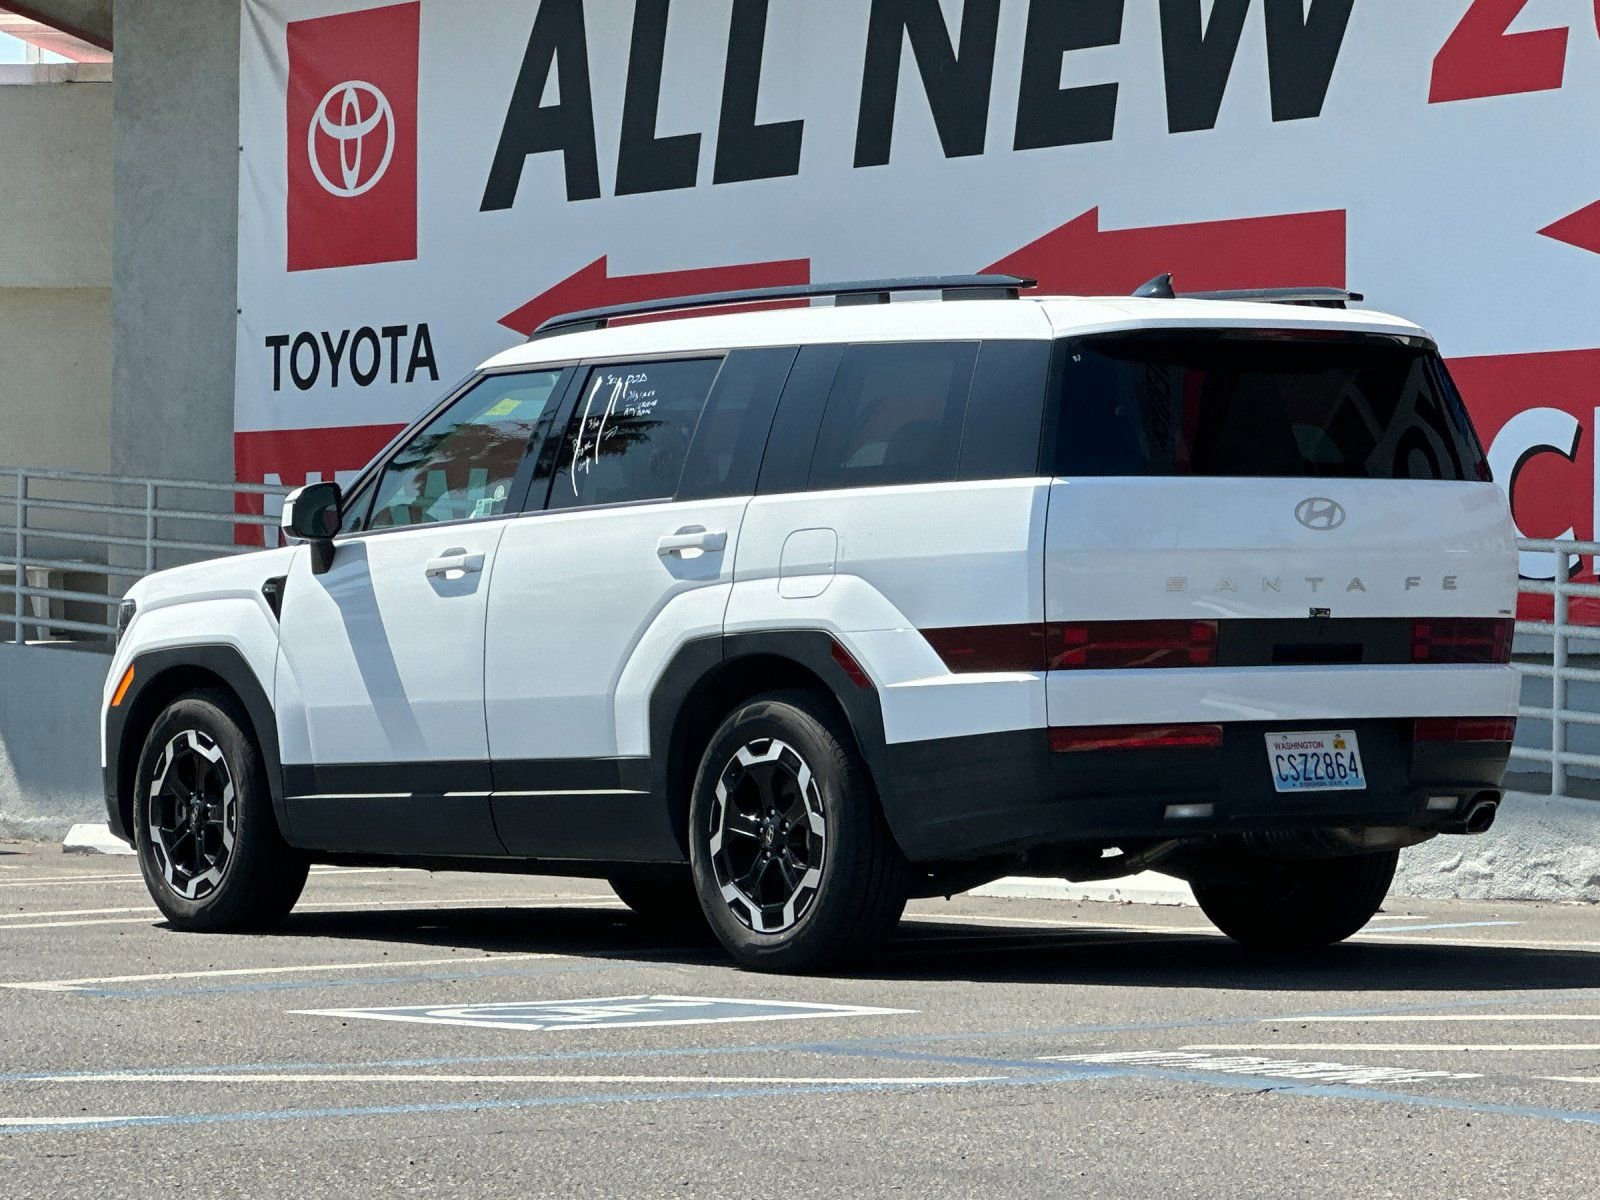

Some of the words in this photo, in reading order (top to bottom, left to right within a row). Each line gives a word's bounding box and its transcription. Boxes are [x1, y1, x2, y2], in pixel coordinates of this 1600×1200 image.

[479, 0, 805, 212] ALL
[853, 0, 1355, 168] NEW
[265, 322, 439, 391] TOYOTA
[1165, 576, 1366, 592] SANTA
[1405, 575, 1458, 590] FE
[1273, 740, 1324, 751] WASHINGTON
[1275, 751, 1359, 783] CSZ2864
